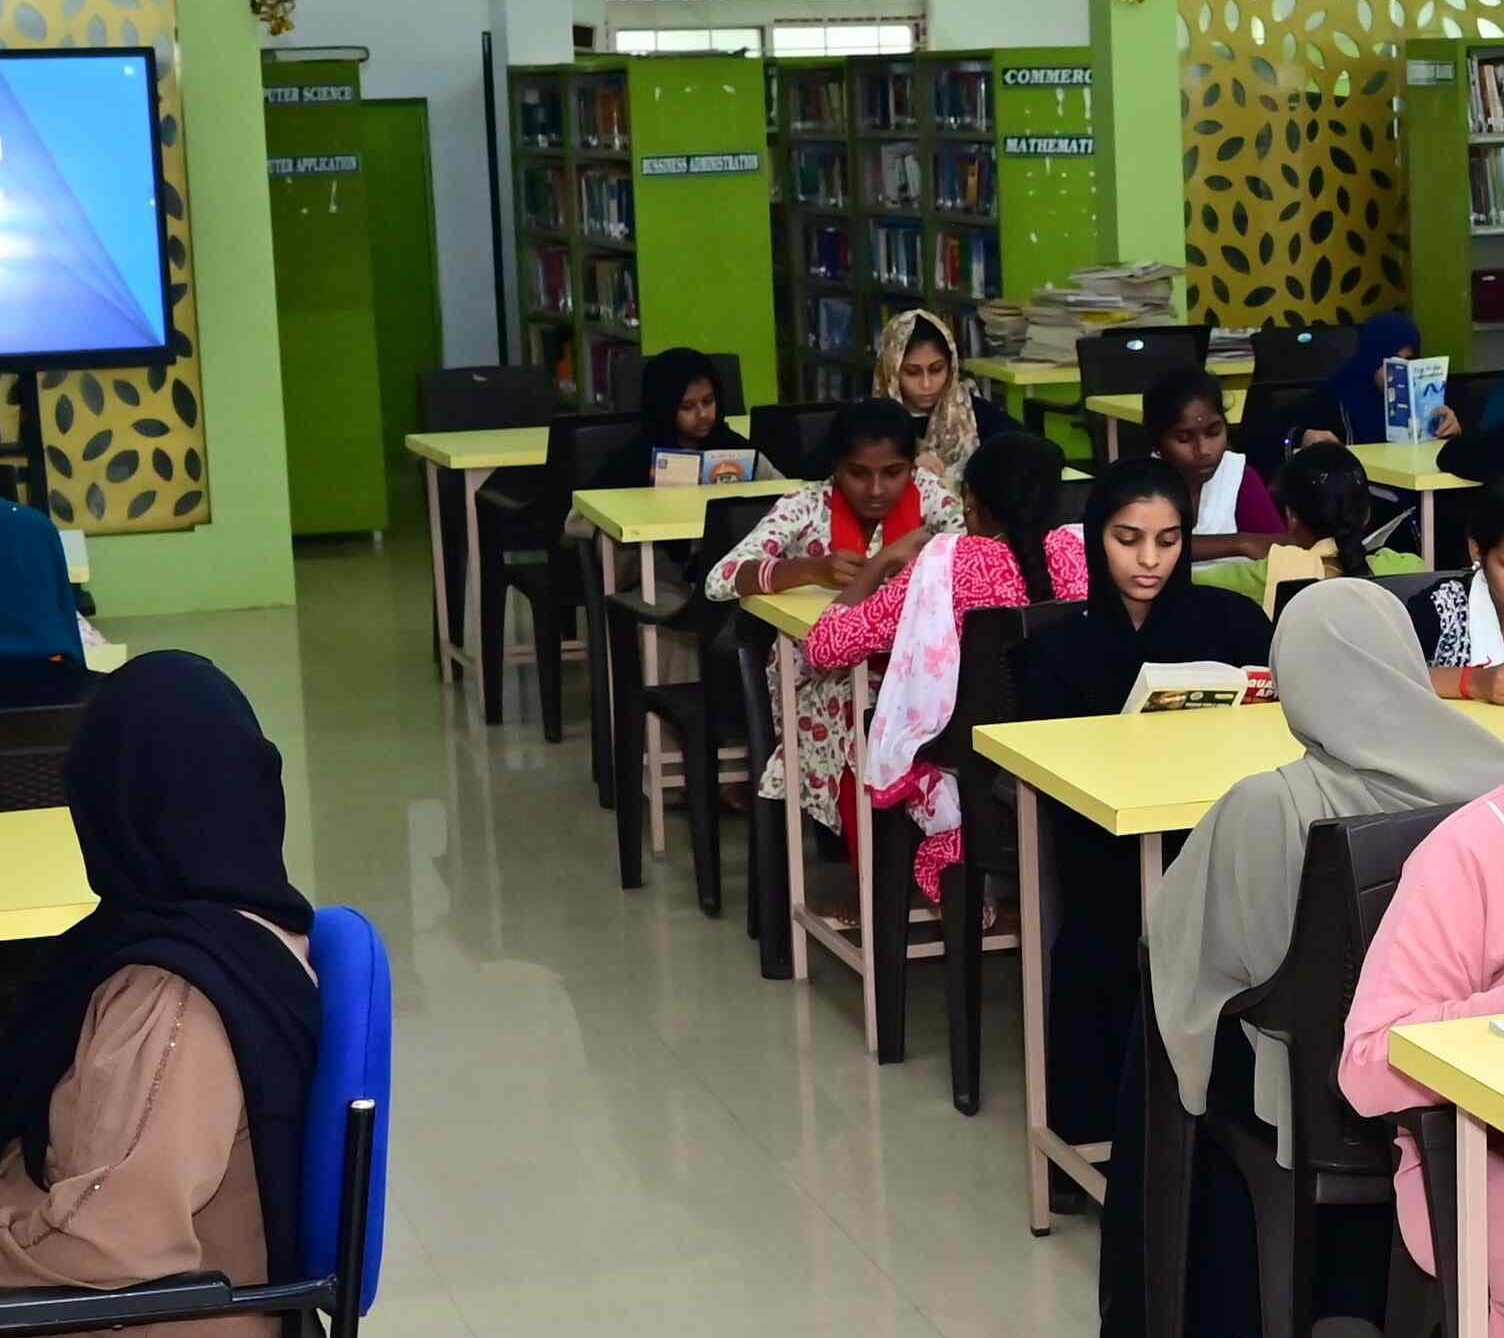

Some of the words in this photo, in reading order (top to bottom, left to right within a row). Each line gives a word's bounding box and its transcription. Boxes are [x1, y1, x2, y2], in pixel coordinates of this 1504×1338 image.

[1003, 68, 1093, 86] COMMERC
[303, 86, 353, 102] SCIENCE
[1005, 137, 1094, 154] MATHEMATI
